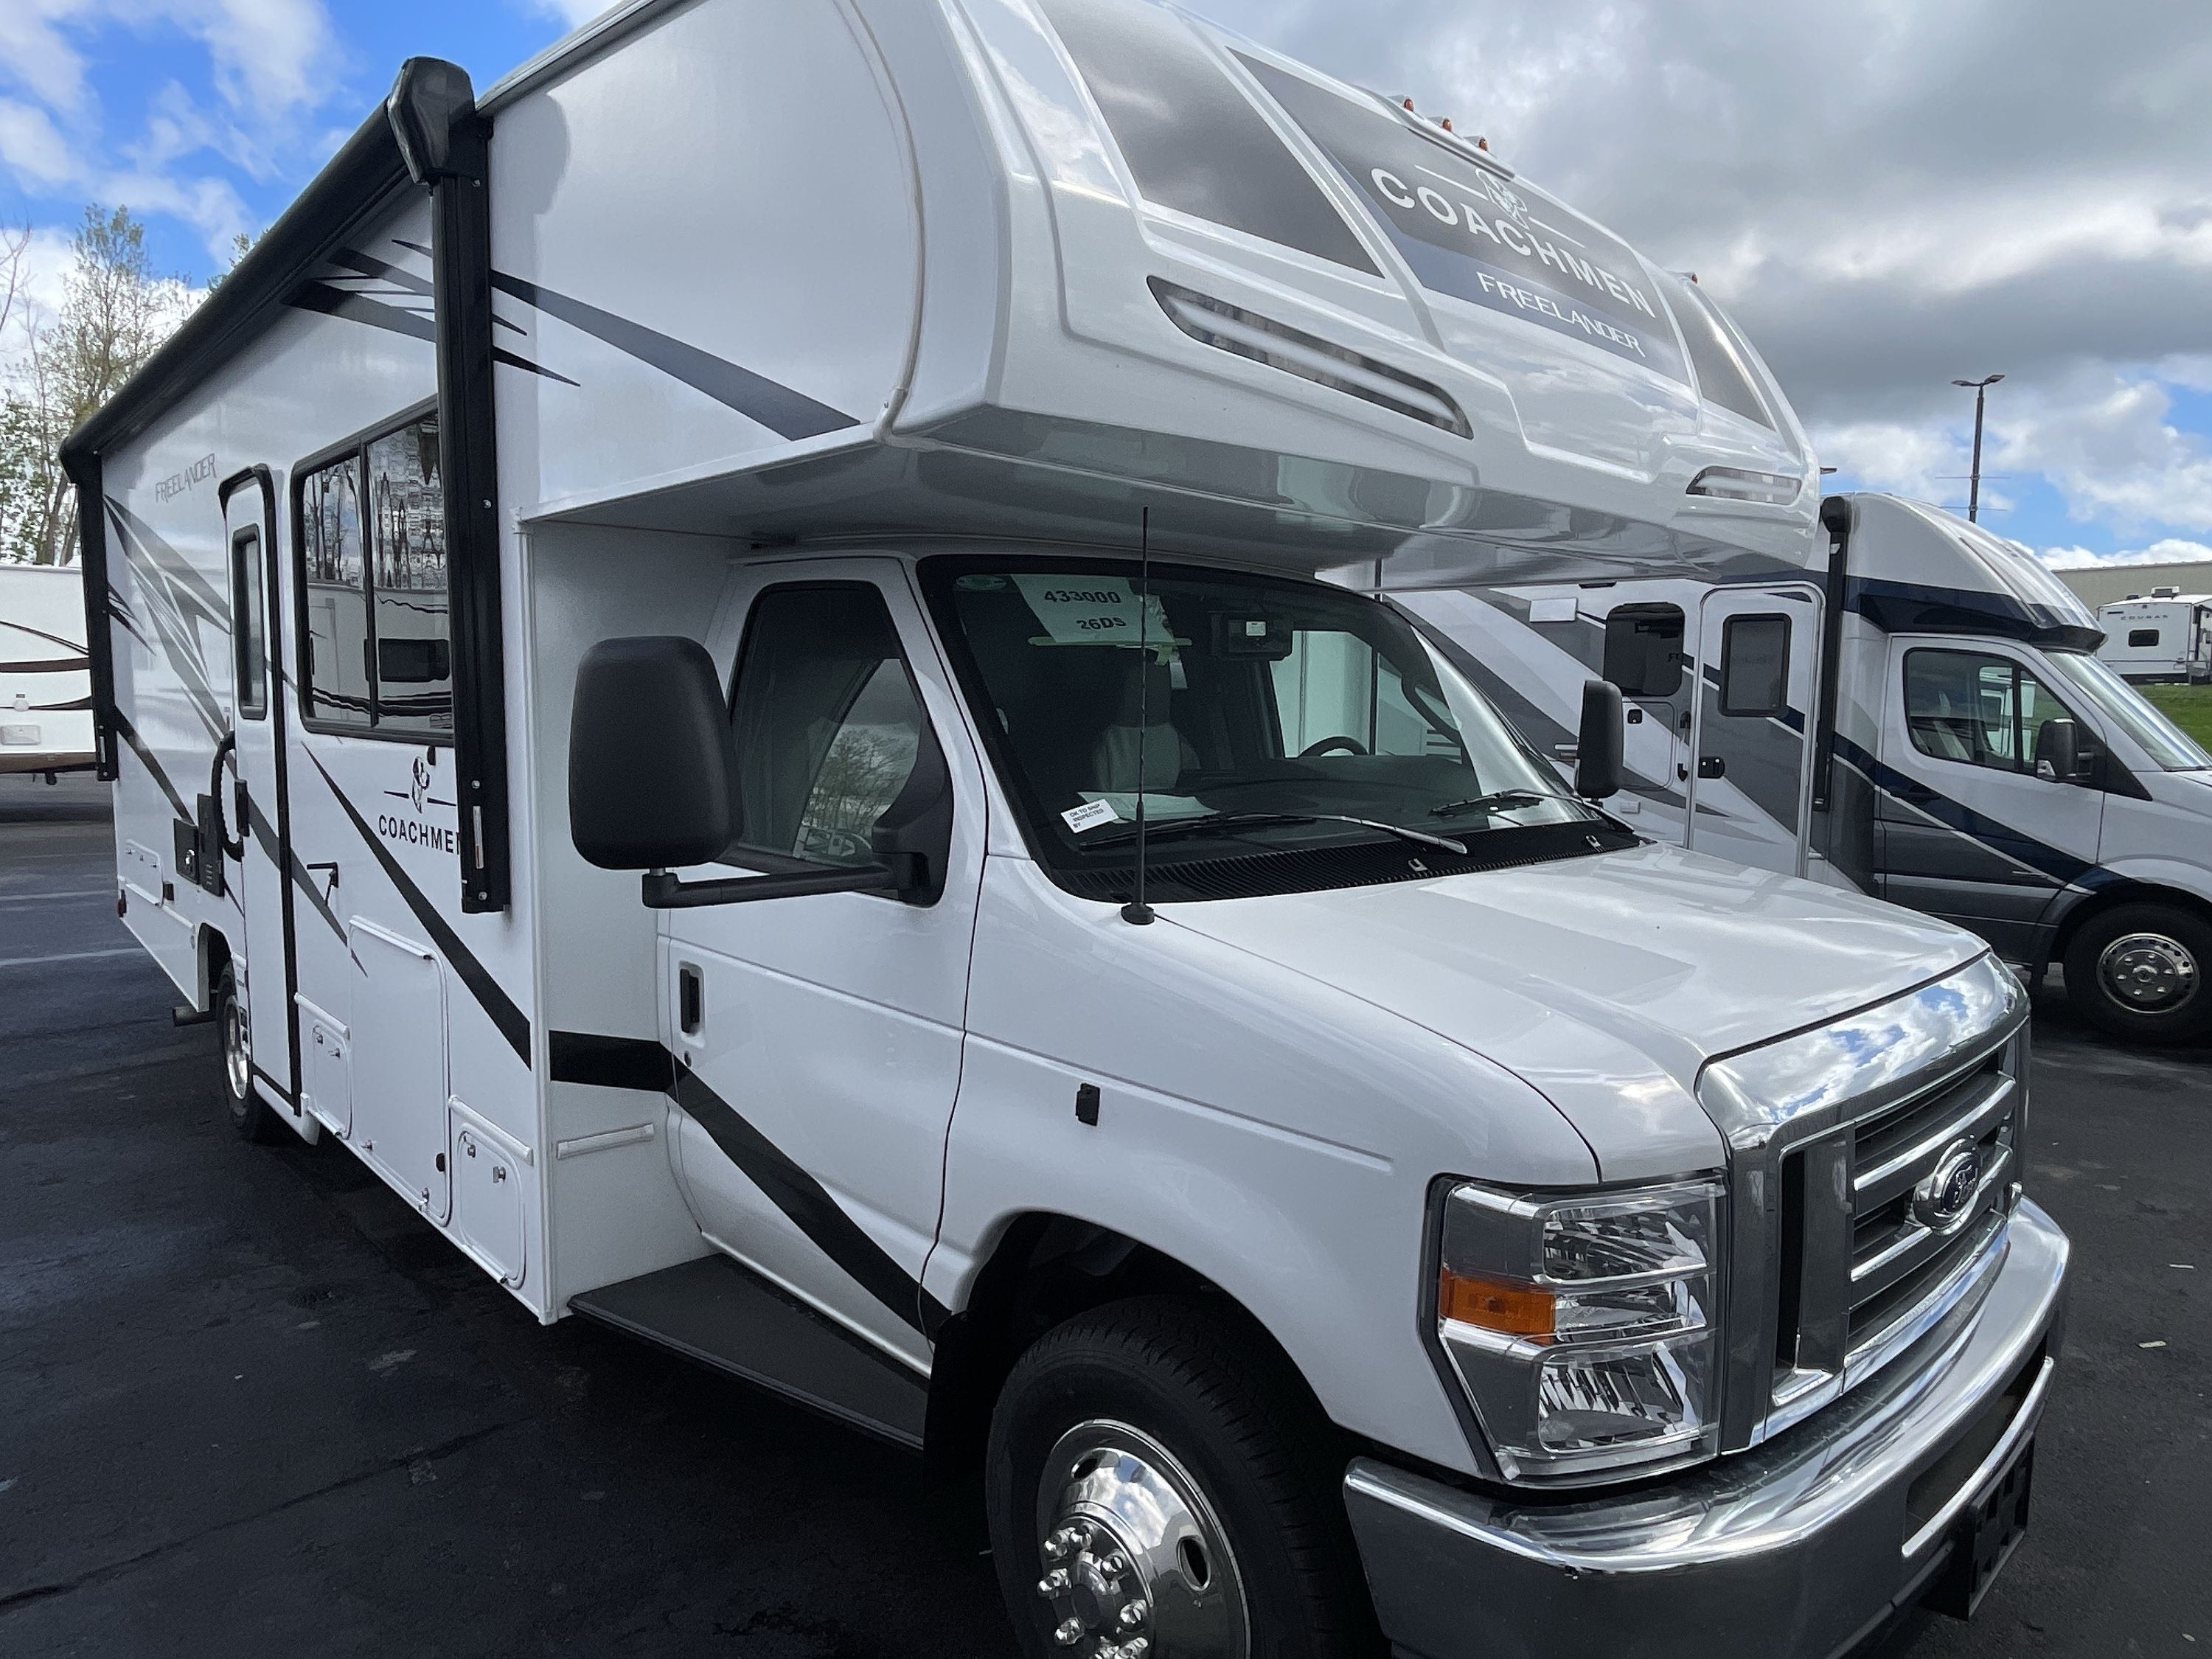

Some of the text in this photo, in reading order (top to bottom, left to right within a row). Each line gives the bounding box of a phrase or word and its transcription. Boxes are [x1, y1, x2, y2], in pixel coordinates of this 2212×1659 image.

[1371, 167, 1655, 319] COACHMEN
[1477, 271, 1646, 358] FREELANDER
[156, 453, 218, 504] FREELANDER
[1044, 590, 1121, 604] 433000
[1077, 616, 1127, 630] 26DS
